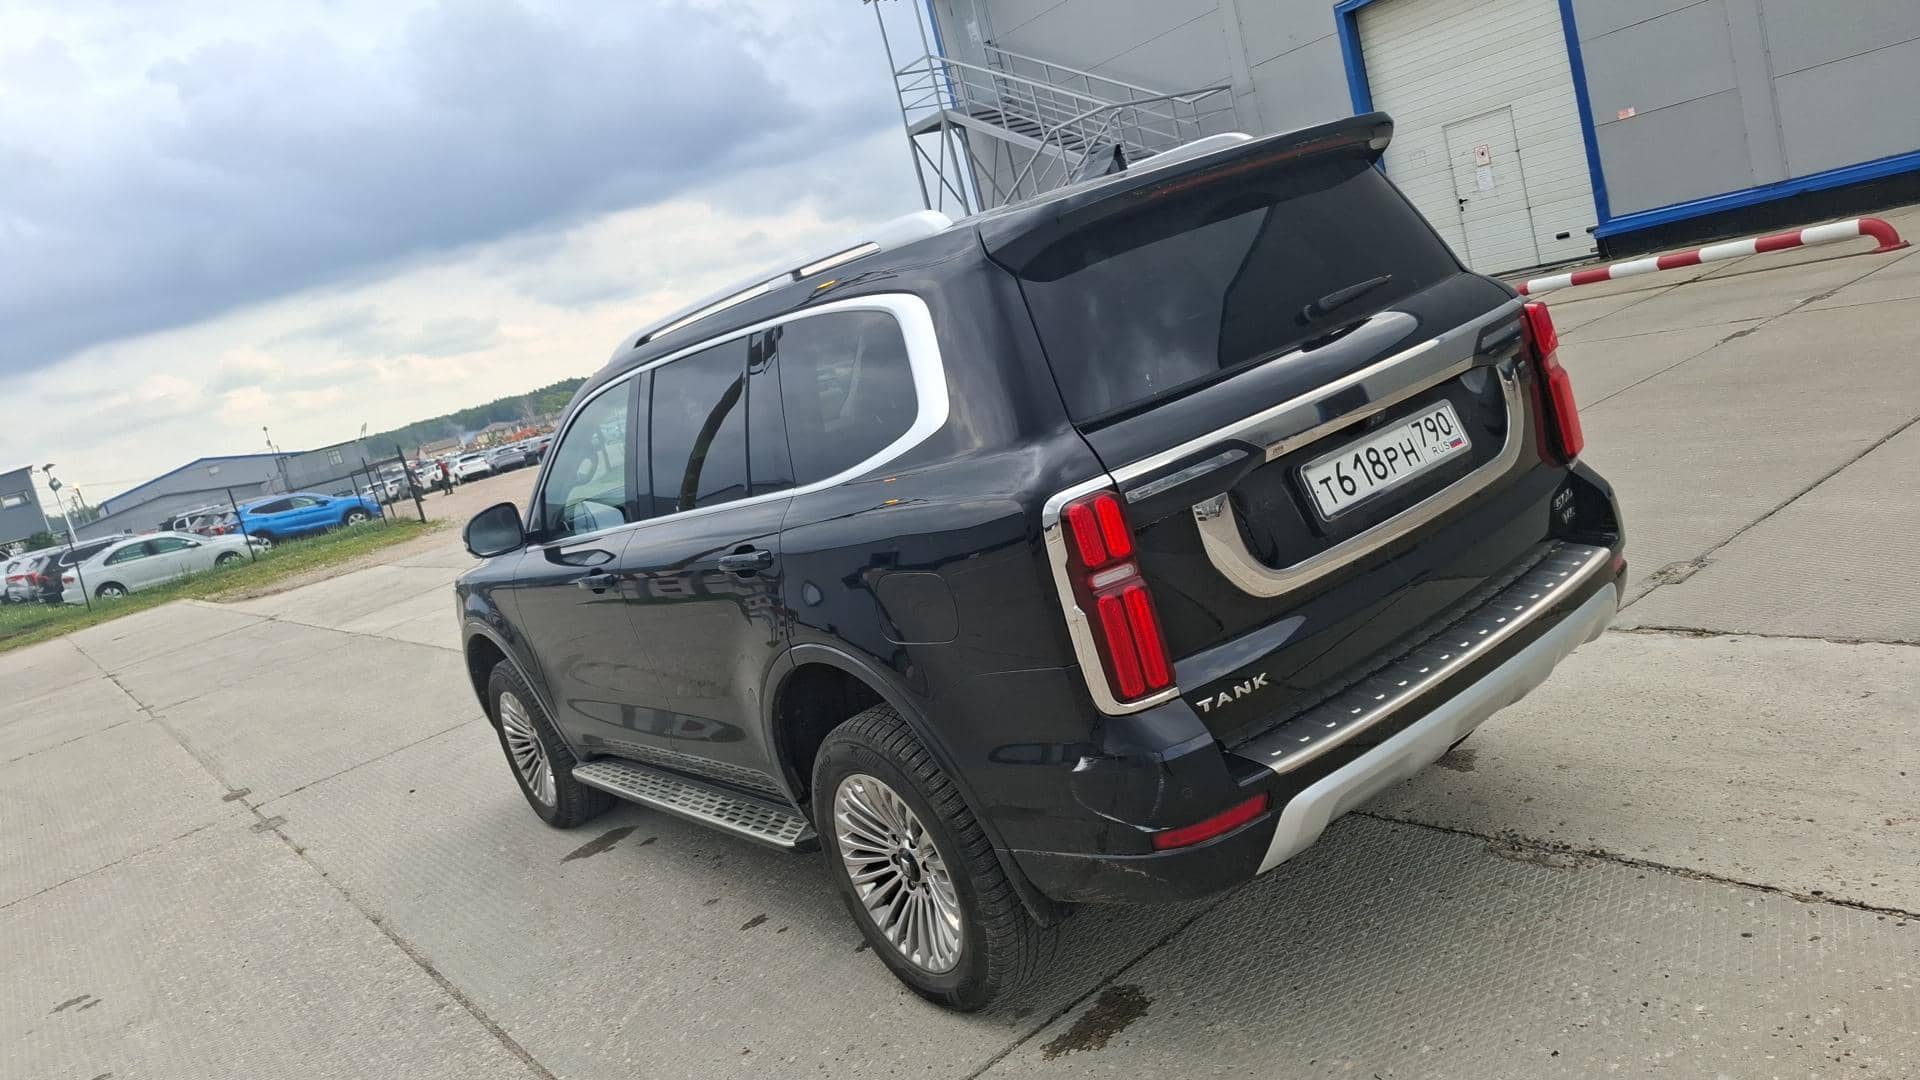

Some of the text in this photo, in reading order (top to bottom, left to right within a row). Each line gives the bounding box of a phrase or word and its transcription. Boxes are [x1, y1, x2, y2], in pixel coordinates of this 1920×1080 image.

[1319, 411, 1453, 504] Т618РН 790
[1432, 441, 1451, 456] RUS
[1195, 672, 1269, 713] TANK
